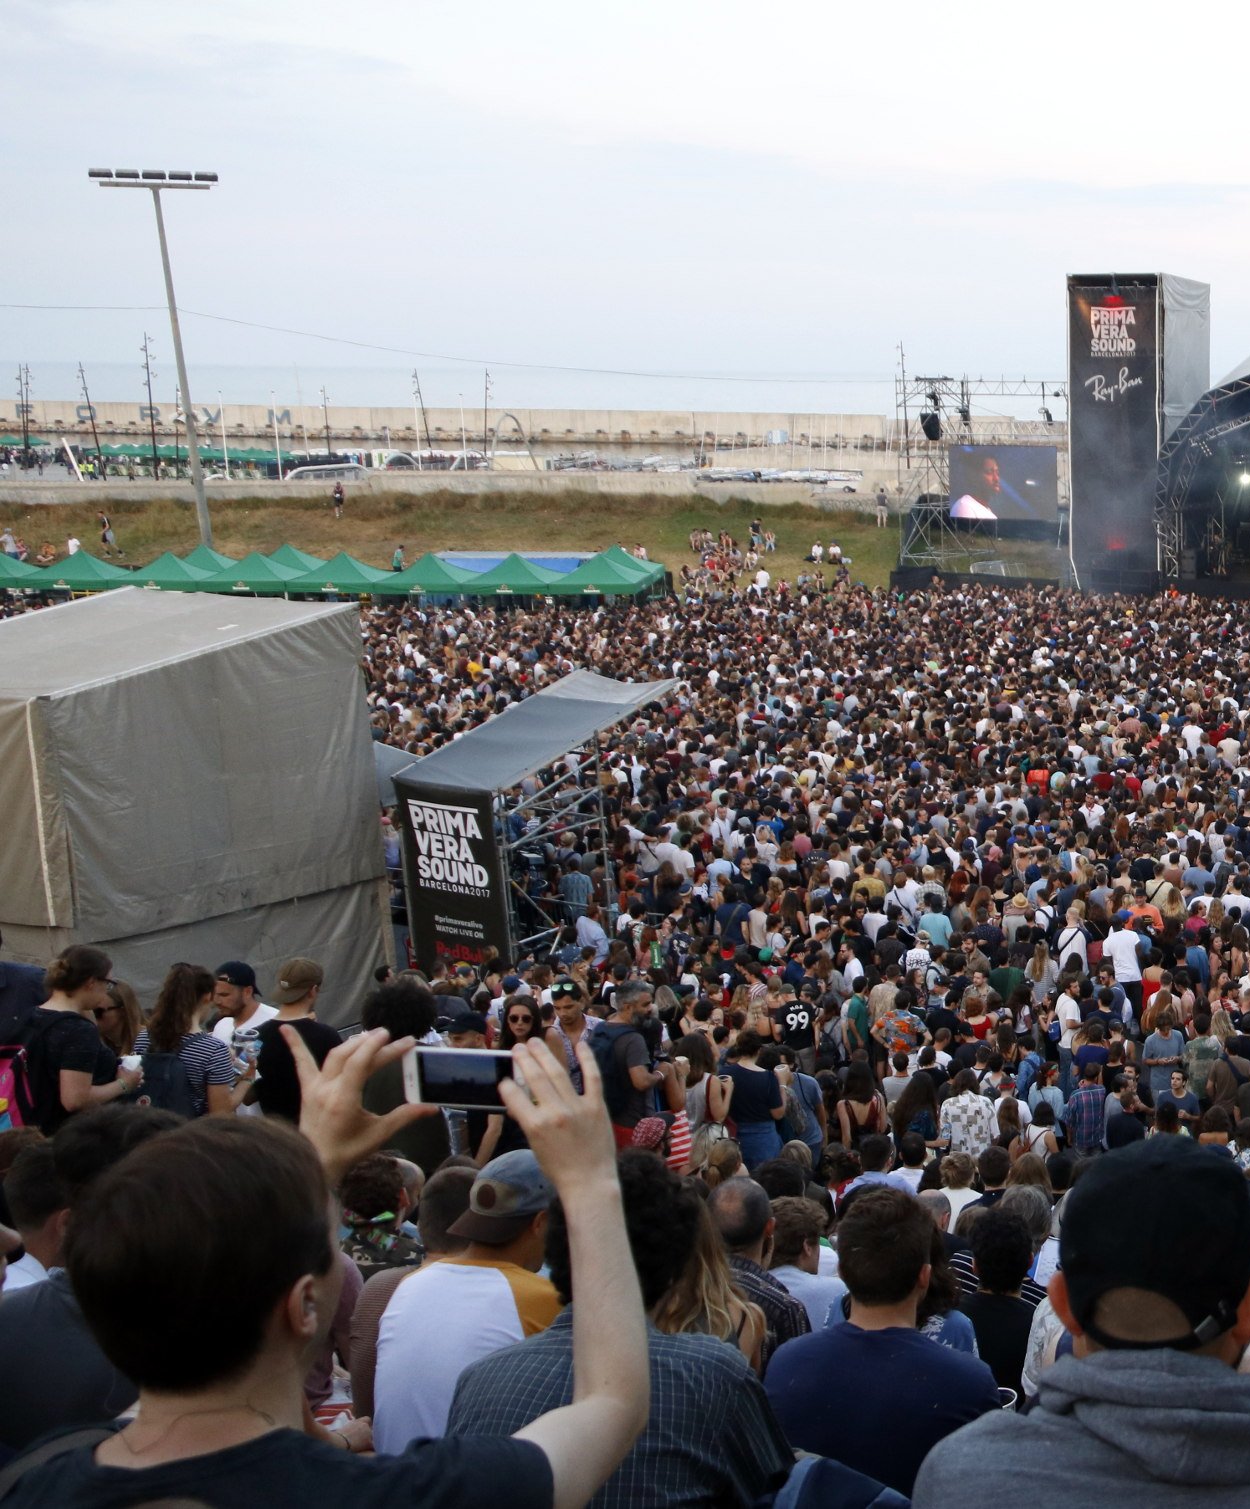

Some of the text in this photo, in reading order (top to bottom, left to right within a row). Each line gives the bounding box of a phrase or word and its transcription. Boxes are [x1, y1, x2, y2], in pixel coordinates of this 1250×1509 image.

[1091, 310, 1136, 324] PRIMA
[1091, 325, 1129, 339] VERA
[1091, 339, 1136, 352] SOUND
[1085, 367, 1142, 402] Ray-Ban
[408, 804, 483, 840] PRIMA
[414, 829, 475, 863] VERA
[418, 855, 489, 887] SOUND
[435, 924, 484, 939] WATCH LIVE ON
[786, 1011, 809, 1031] 99
